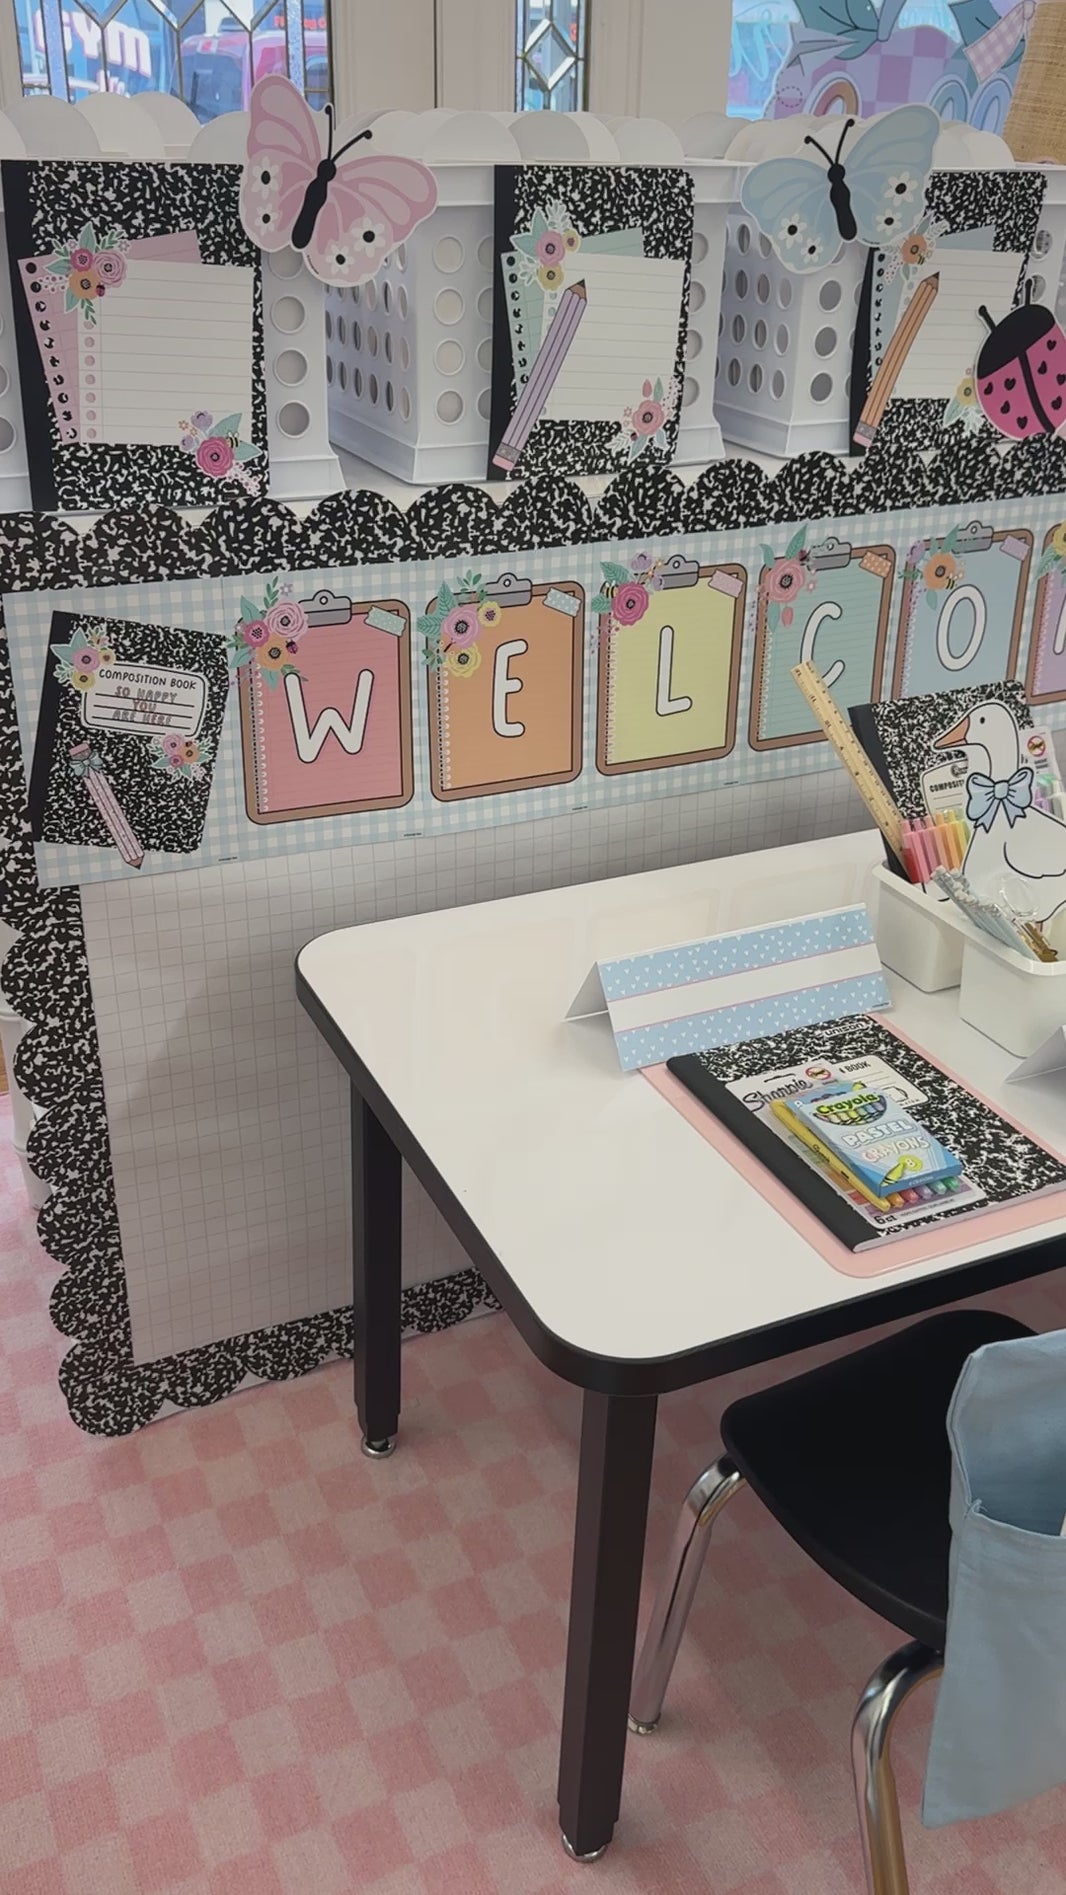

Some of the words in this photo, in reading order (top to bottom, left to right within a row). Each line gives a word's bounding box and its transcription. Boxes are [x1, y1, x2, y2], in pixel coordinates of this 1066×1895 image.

[99, 668, 166, 686] COMPOSITION
[170, 678, 197, 690] BOOK
[114, 686, 131, 697] SO
[137, 688, 178, 704] HAPPY
[132, 699, 157, 712] YOU
[112, 709, 137, 721] ARE
[142, 715, 172, 726] HERE
[824, 1022, 864, 1037] unison
[844, 1060, 872, 1074] BOOK
[742, 1078, 813, 1112] Sharpie
[816, 1091, 882, 1115] Crayola
[842, 1120, 914, 1147] PASTEL
[862, 1136, 930, 1162] CRAYONS
[906, 1157, 916, 1168] 8
